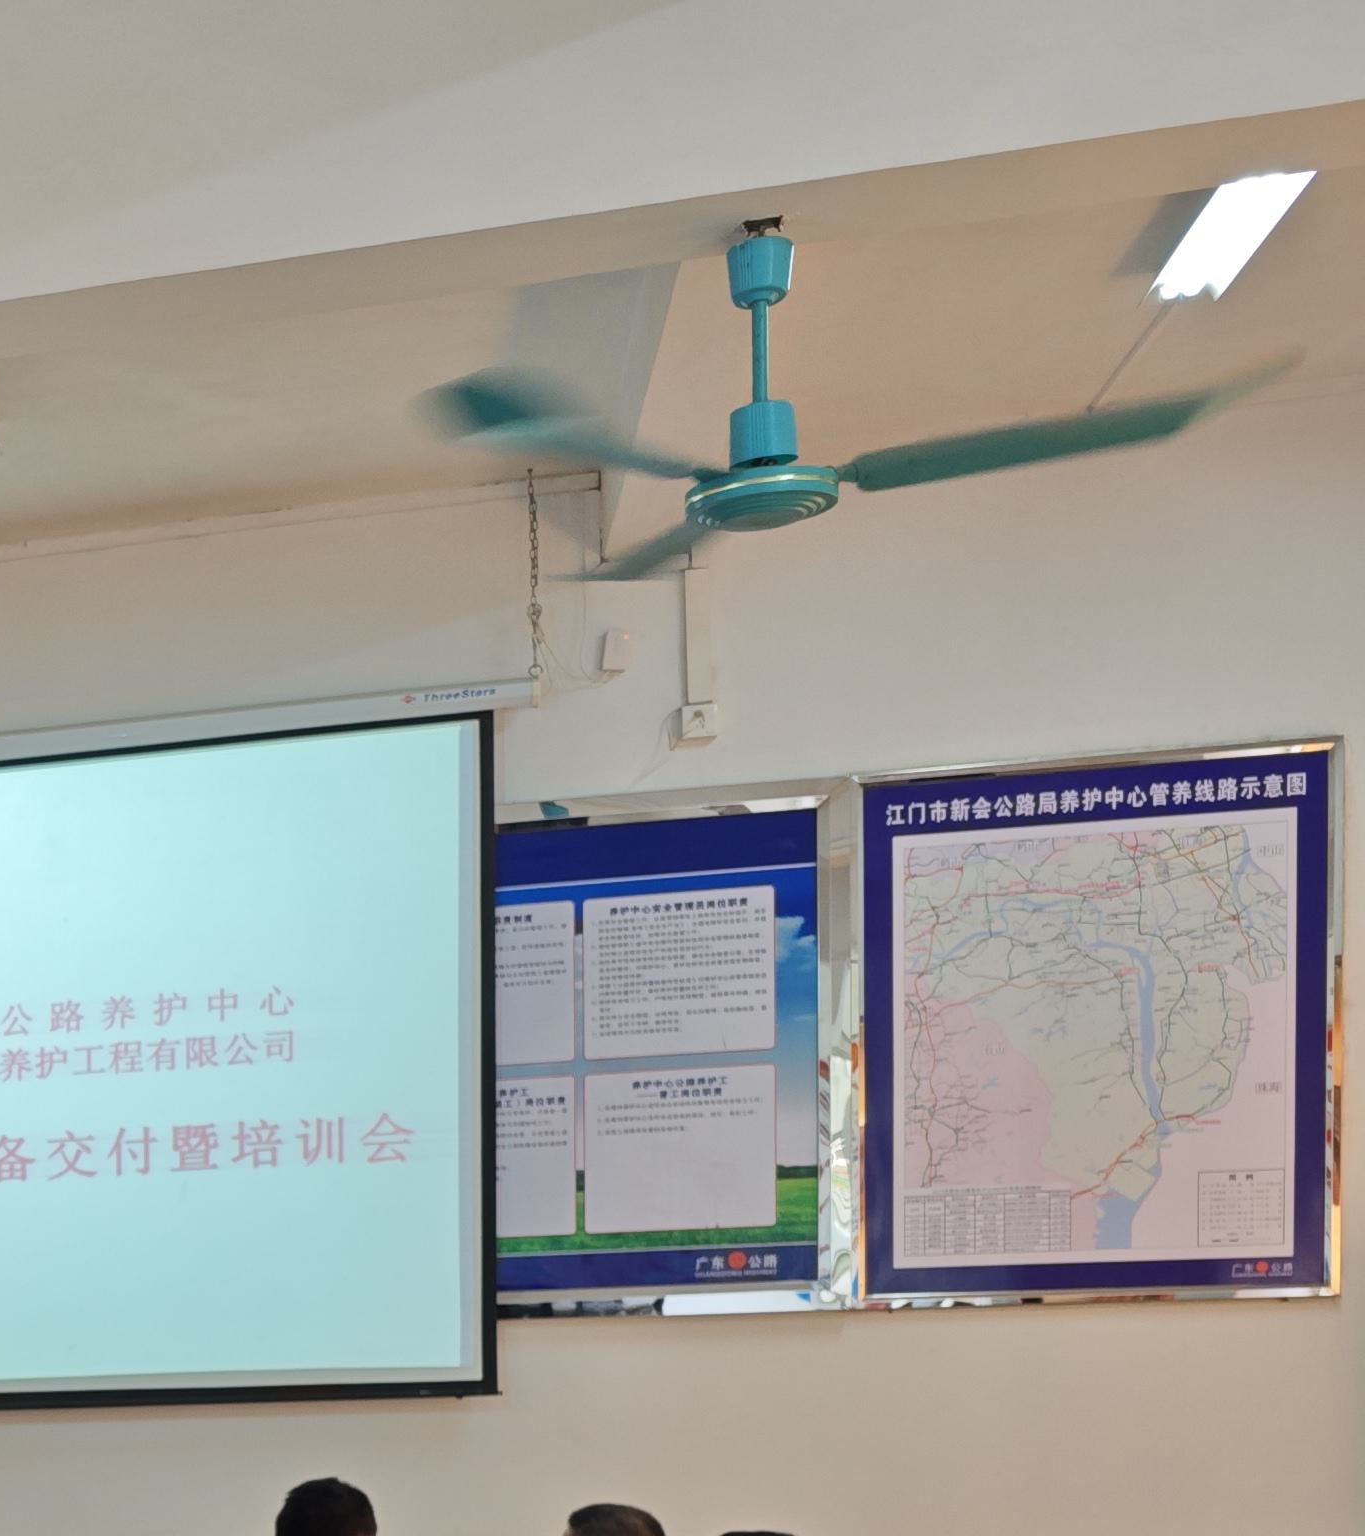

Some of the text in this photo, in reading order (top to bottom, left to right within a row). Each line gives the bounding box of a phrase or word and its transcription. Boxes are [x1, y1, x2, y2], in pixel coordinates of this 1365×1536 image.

[423, 688, 496, 703] ThreeStars
[886, 772, 1307, 826] 江门市新会公路局养护中心管养线路示意图
